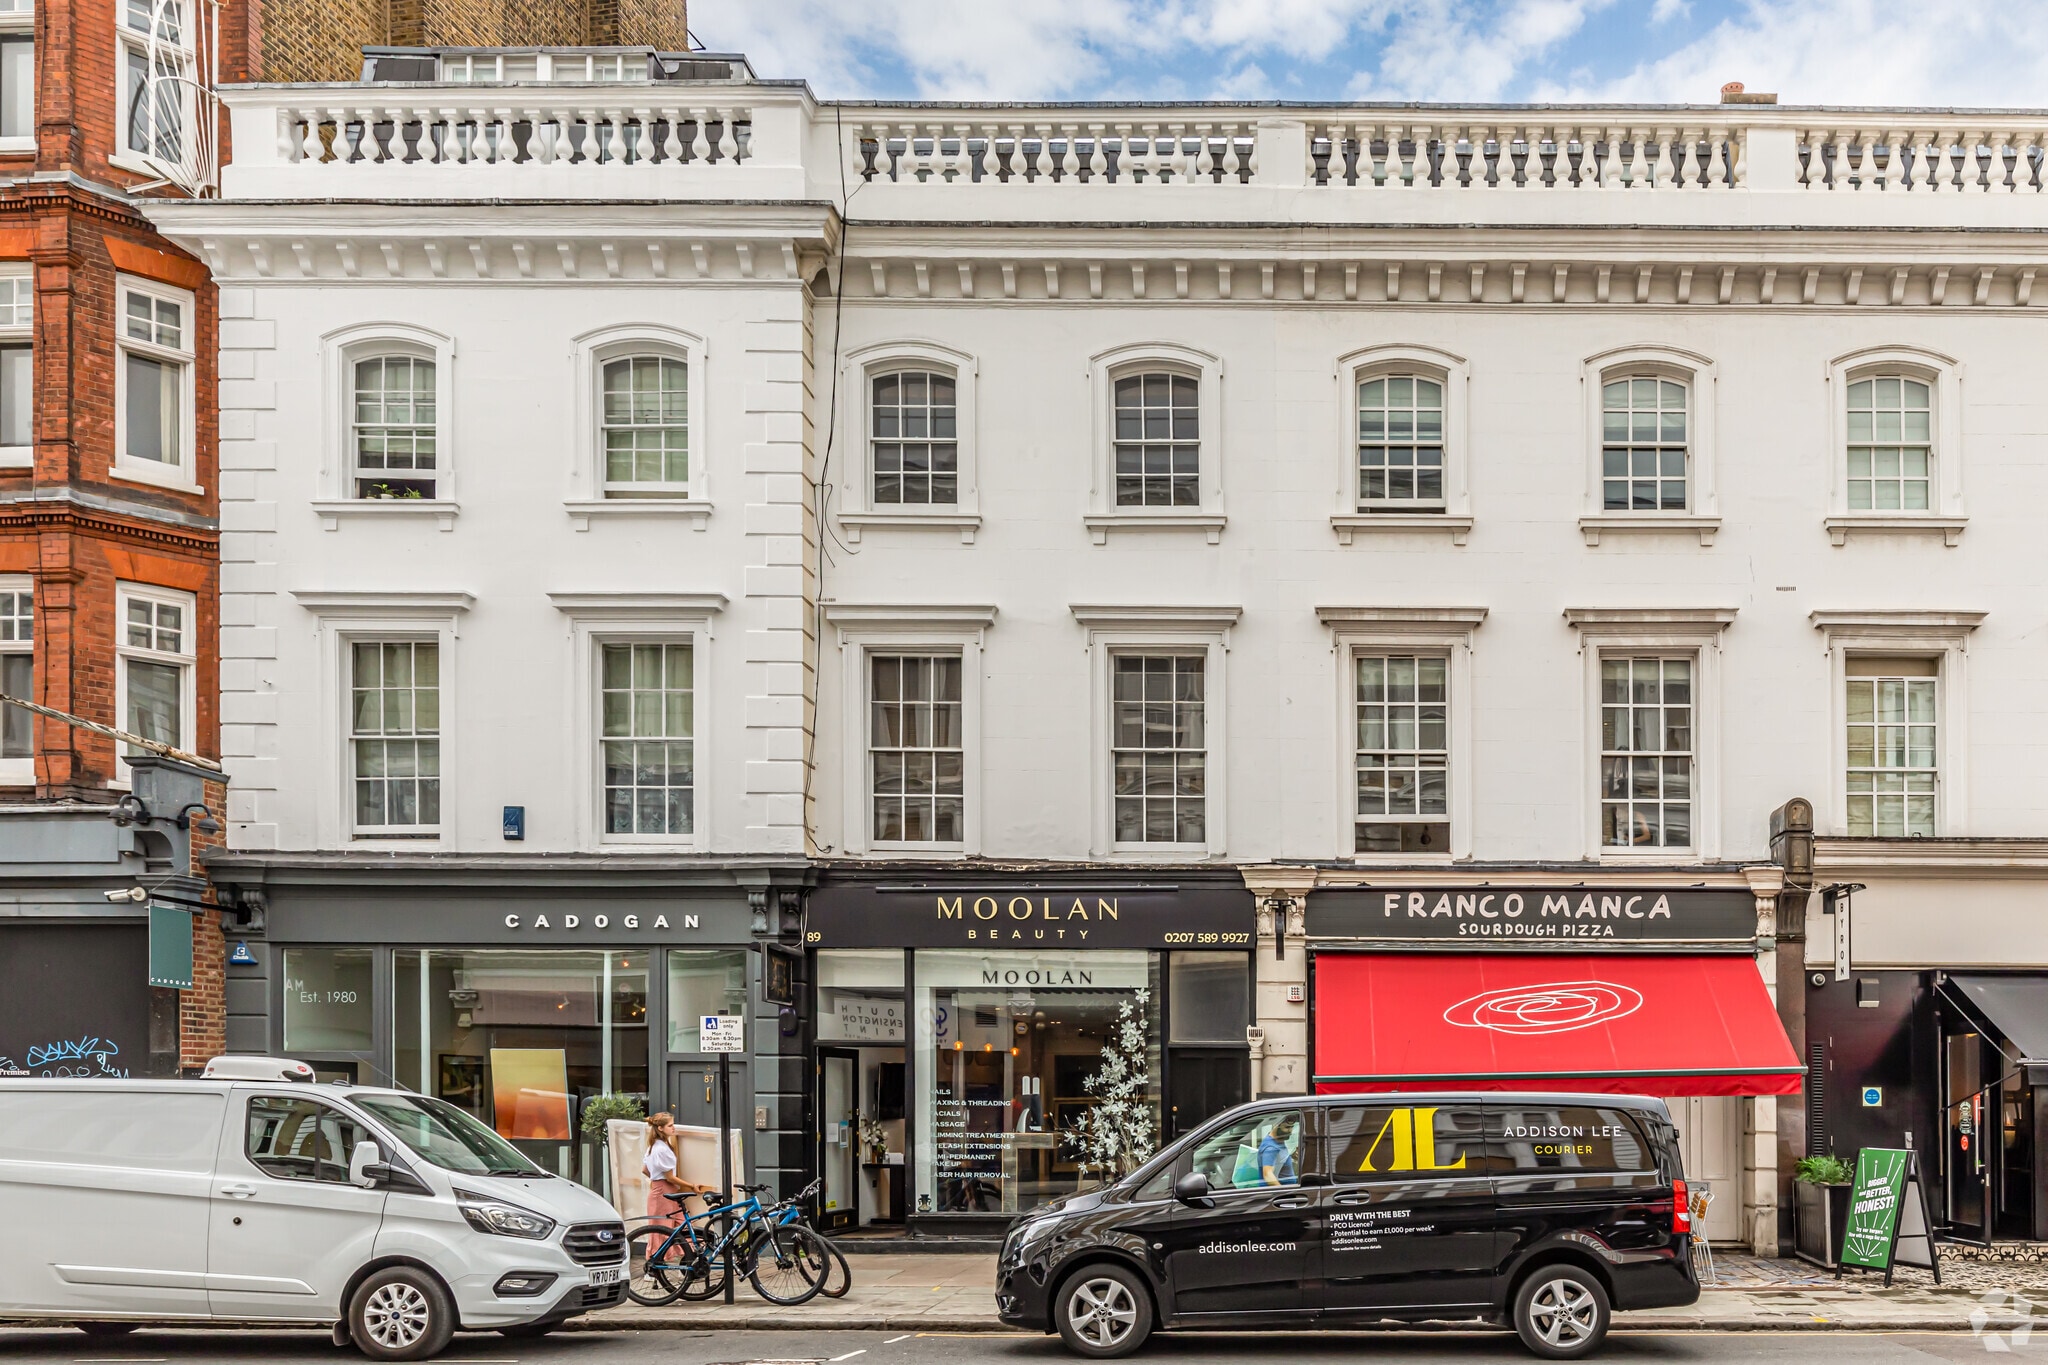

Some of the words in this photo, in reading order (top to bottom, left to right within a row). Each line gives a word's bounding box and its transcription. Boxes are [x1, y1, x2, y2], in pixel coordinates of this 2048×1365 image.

[936, 896, 1119, 920] MOOLAN
[1383, 892, 1524, 918] FRANCO
[1541, 893, 1671, 919] MANCA
[504, 914, 699, 928] CADOGAN
[968, 929, 1089, 939] BEAUTY
[1459, 922, 1556, 936] SOURDOUGH
[1562, 924, 1614, 937] PIZZA
[806, 932, 821, 942] 89
[1164, 932, 1195, 943] 0207
[1197, 932, 1218, 944] 589
[1221, 933, 1250, 944] 9927
[151, 977, 192, 986] CADOGAN
[982, 970, 1093, 985] MOOLAN
[300, 992, 321, 1003] Est.
[327, 991, 357, 1003] 1980
[704, 1075, 714, 1084] 87
[1504, 1126, 1583, 1137] ADDISON
[1592, 1126, 1622, 1137] LEE
[1534, 1145, 1593, 1155] COURIER
[1867, 1177, 1888, 1188] BIGGER
[1865, 1186, 1892, 1198] BETTER,
[1854, 1195, 1896, 1215] HONEST!
[1329, 1213, 1353, 1222] DRIVE
[1354, 1212, 1376, 1220] WITH
[1376, 1211, 1392, 1219] THE
[1392, 1210, 1411, 1218] BEST
[1348, 1220, 1374, 1229] Licence?
[1334, 1229, 1361, 1237] Potential
[1384, 1226, 1404, 1235] £1,000
[1404, 1226, 1416, 1234] per
[1331, 1236, 1378, 1245] addisonlee.com
[1198, 1240, 1296, 1254] addisonlee.com
[592, 1270, 608, 1284] YR70
[608, 1269, 620, 1282] FBX
